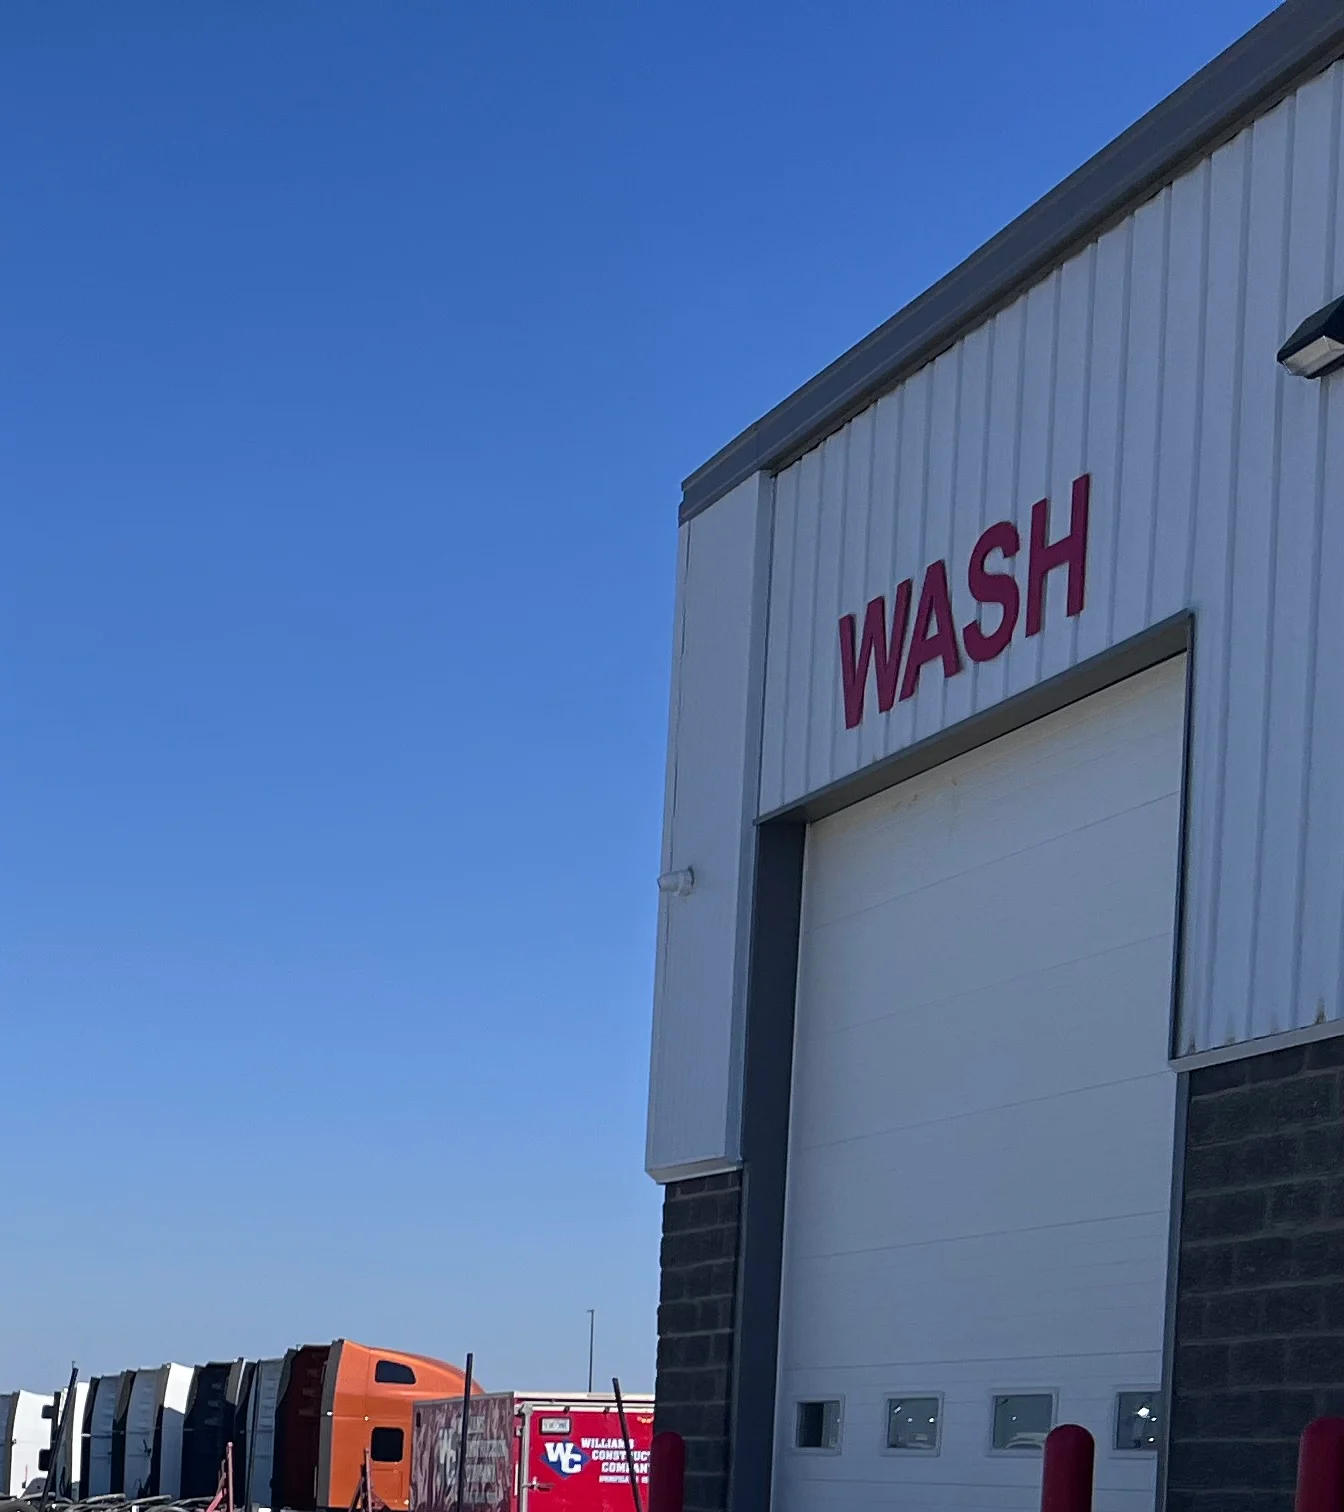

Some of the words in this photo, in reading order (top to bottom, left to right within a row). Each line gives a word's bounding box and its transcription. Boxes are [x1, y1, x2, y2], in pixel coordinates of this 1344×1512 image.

[838, 472, 1090, 730] WASH
[544, 1442, 582, 1474] WC
[591, 1449, 651, 1462] CONSTUC
[601, 1461, 651, 1474] COMAN
